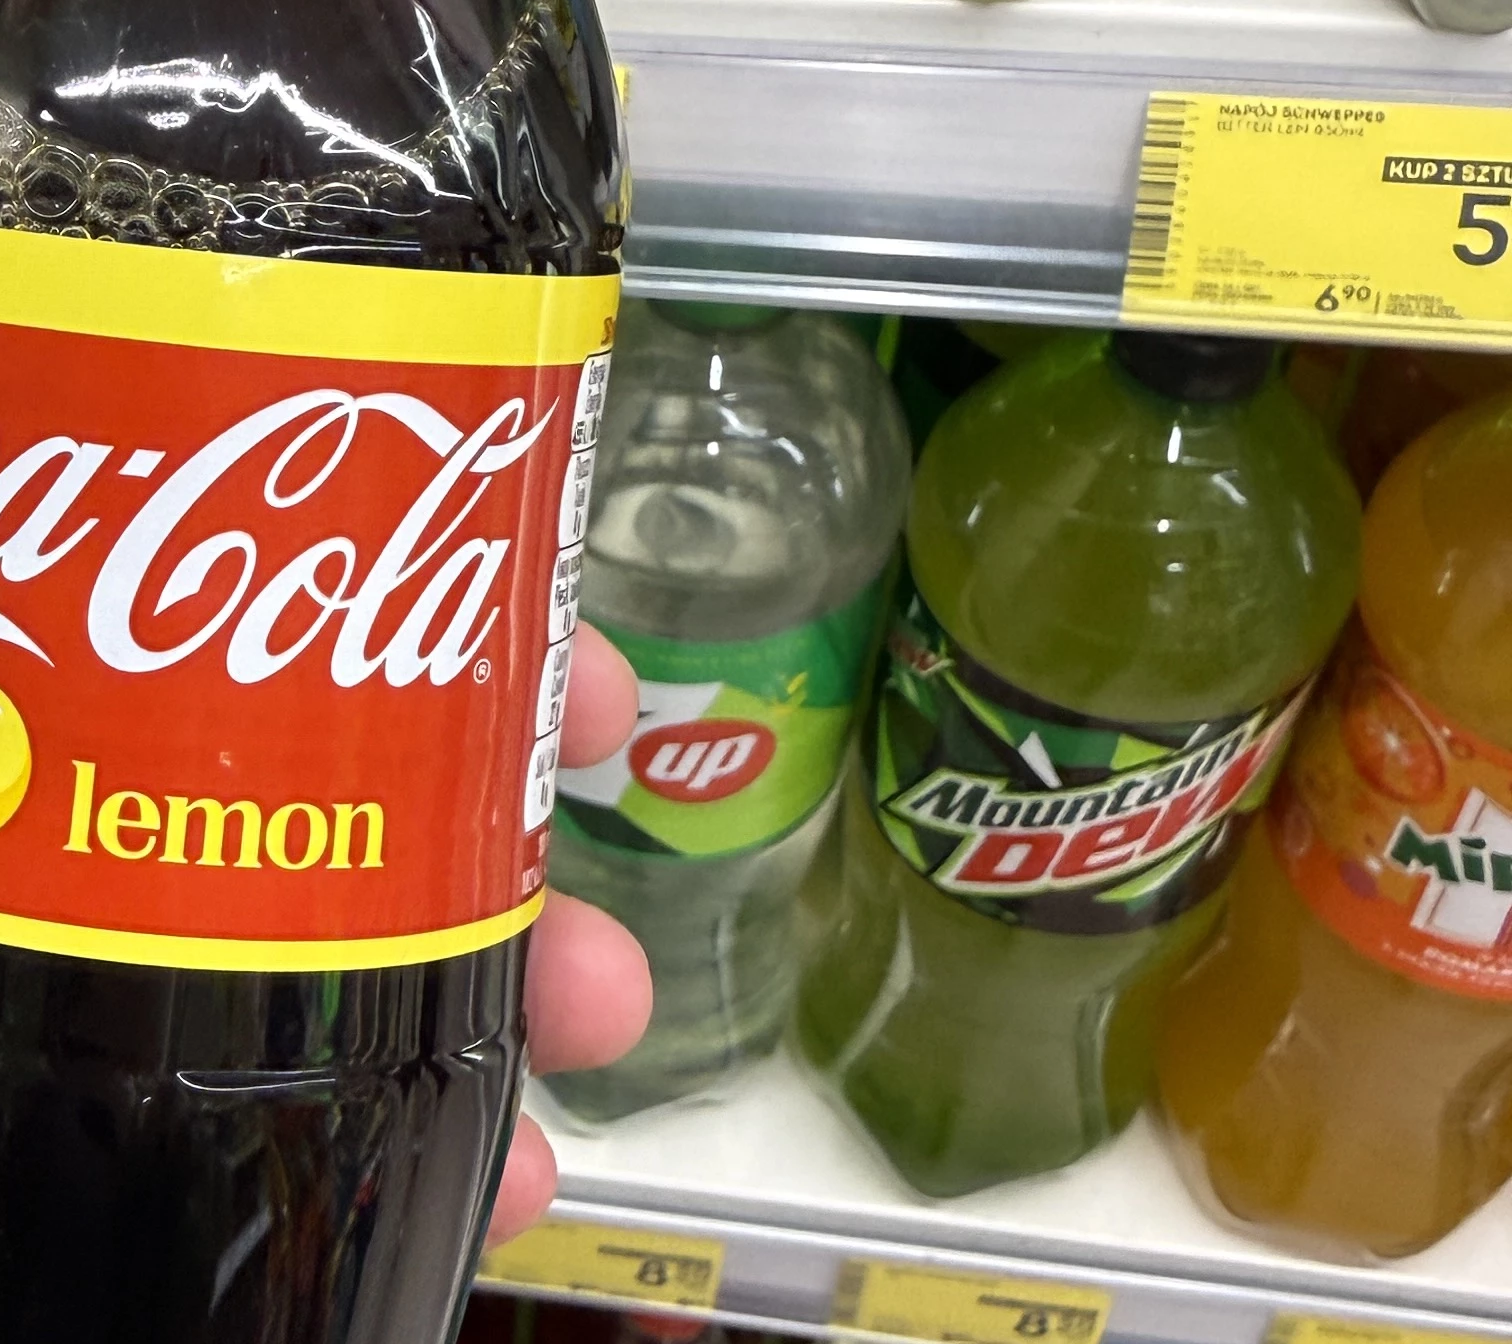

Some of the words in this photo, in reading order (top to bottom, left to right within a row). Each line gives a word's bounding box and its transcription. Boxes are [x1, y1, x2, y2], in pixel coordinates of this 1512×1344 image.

[1389, 160, 1438, 180] KUP
[1442, 163, 1456, 181] 2
[1452, 192, 1512, 266] 5
[646, 732, 760, 791] up
[63, 759, 384, 871] lemon
